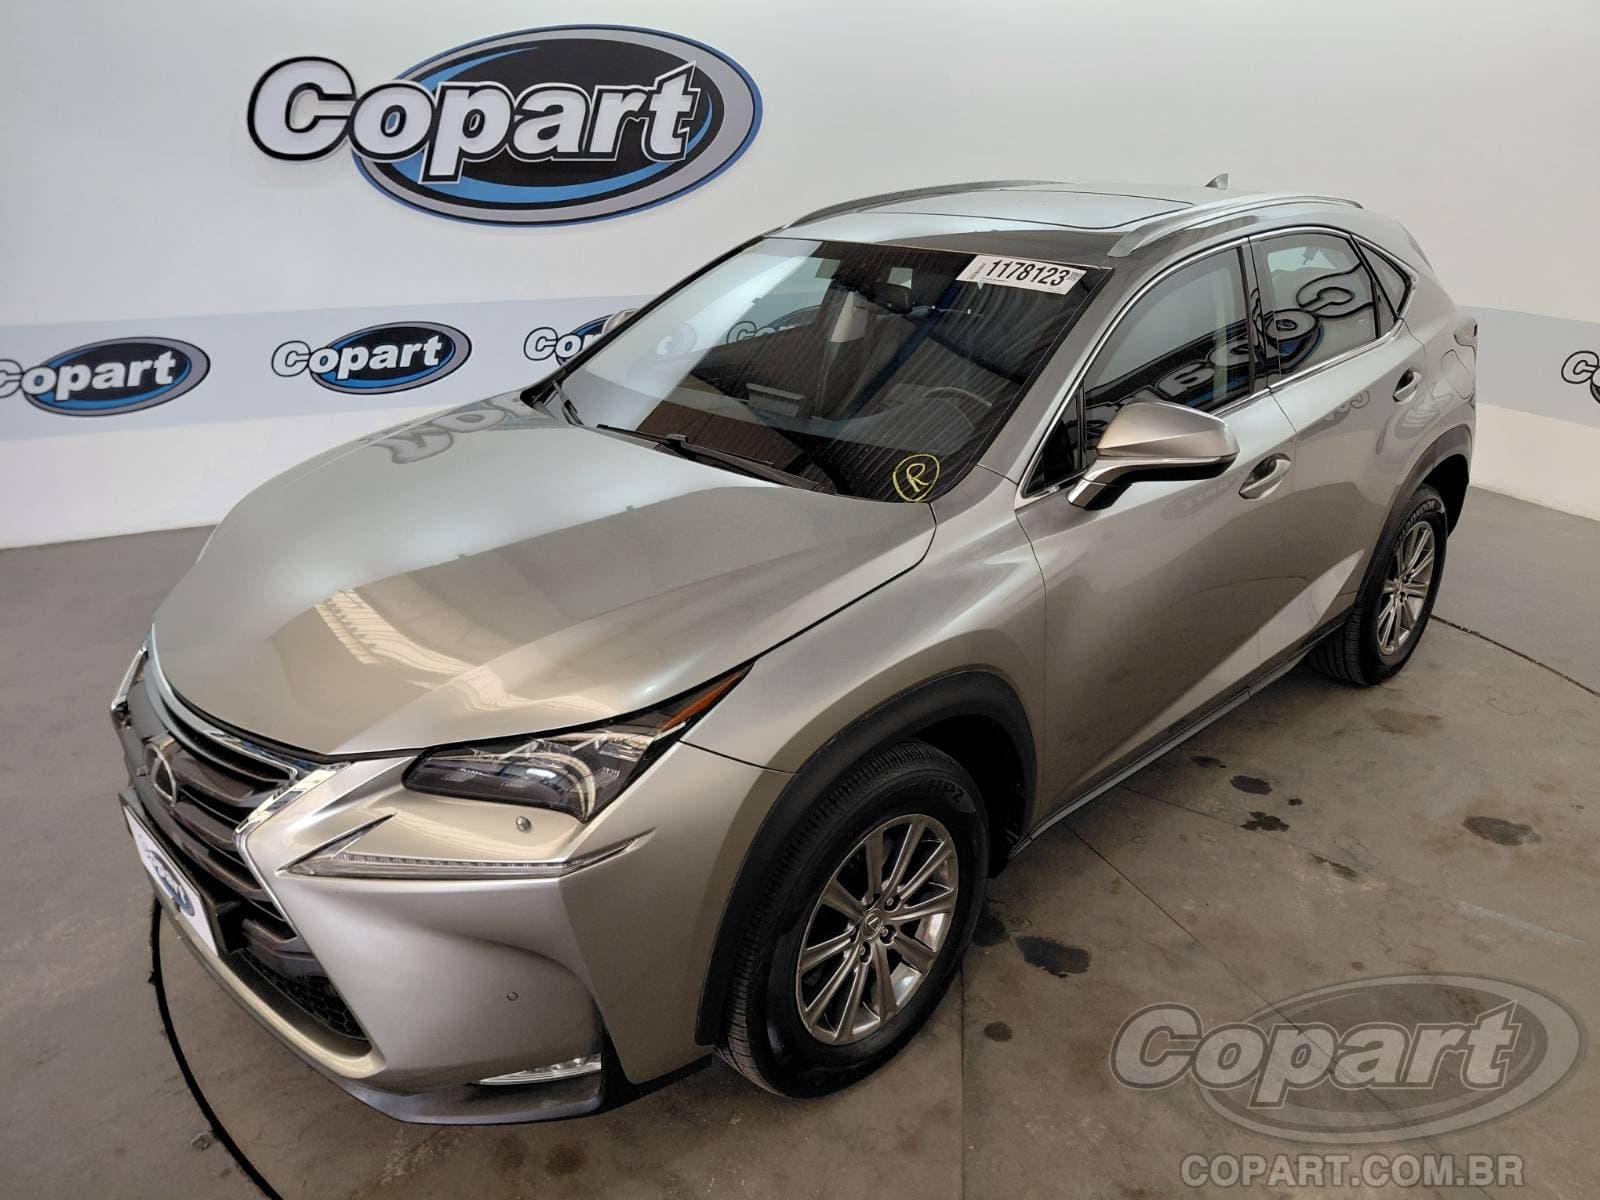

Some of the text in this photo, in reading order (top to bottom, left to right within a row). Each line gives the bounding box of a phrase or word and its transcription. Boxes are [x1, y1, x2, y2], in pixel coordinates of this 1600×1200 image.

[248, 56, 700, 183] Copart
[986, 259, 1070, 286] 1178123
[271, 335, 442, 380] Copart
[906, 463, 929, 492] R
